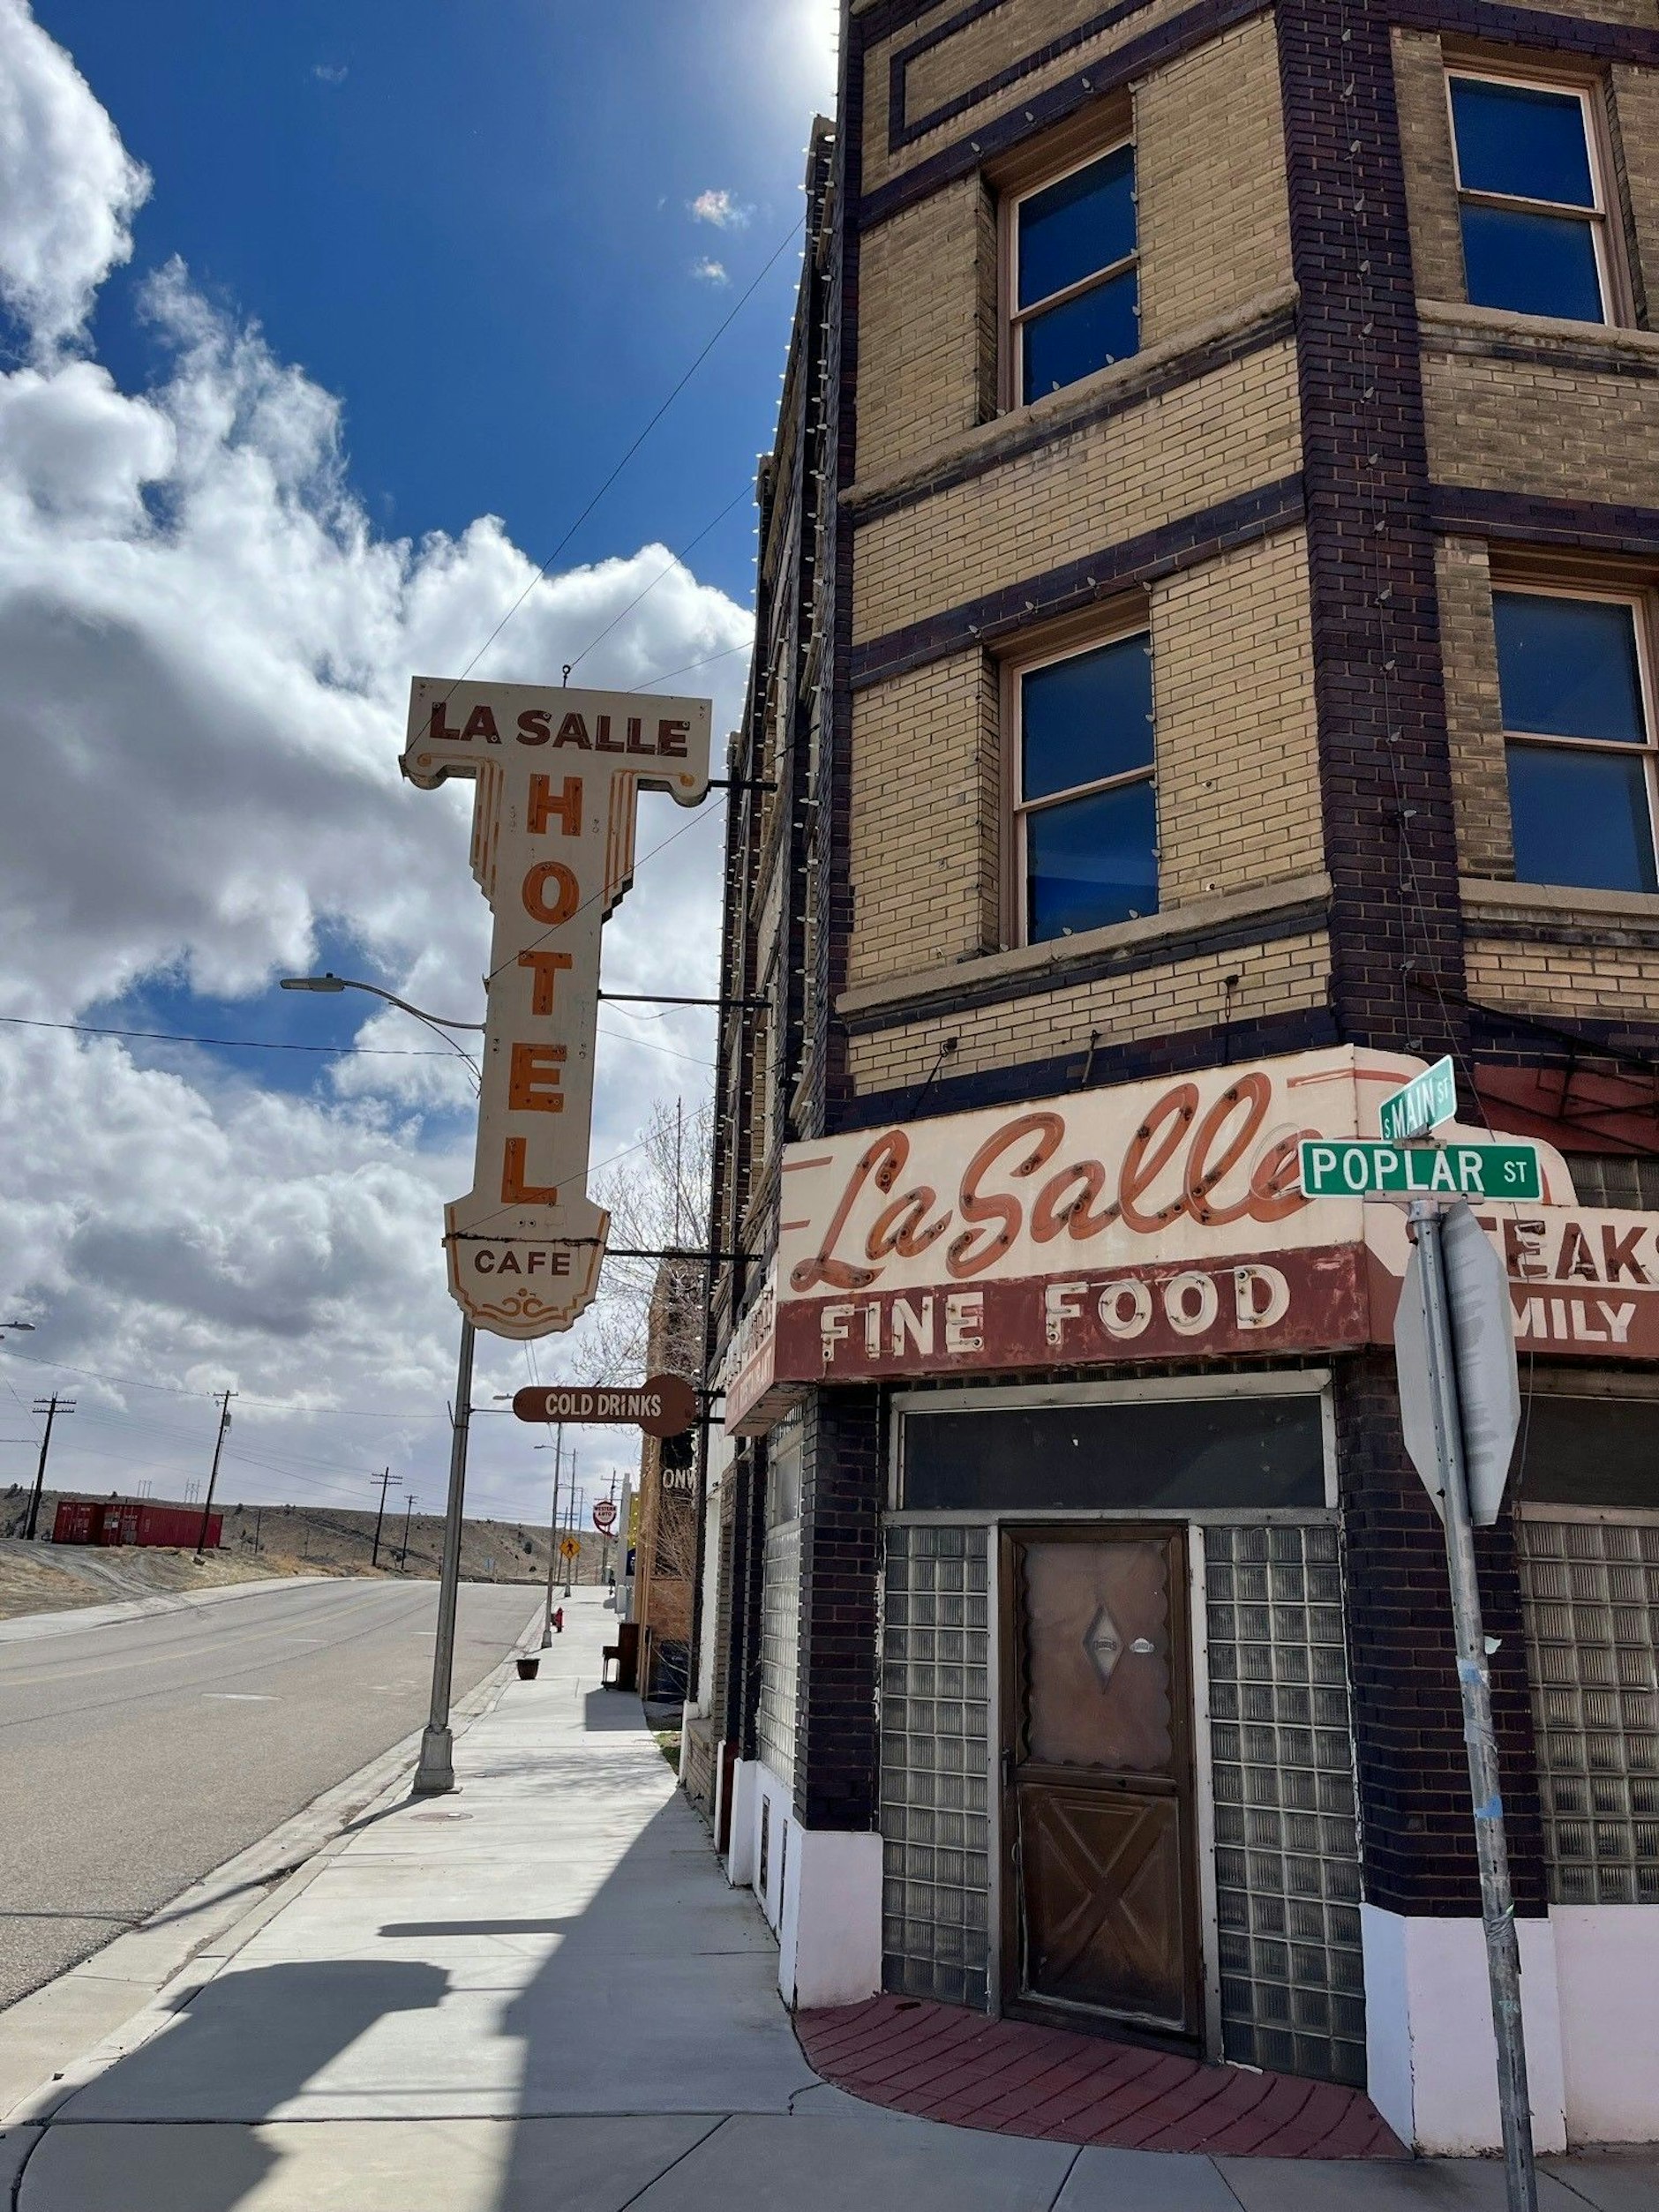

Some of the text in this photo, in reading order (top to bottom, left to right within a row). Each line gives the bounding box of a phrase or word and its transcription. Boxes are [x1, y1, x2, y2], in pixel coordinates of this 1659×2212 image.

[429, 701, 691, 758] LA SALLE
[500, 773, 583, 1205] HOTEL
[1384, 1076, 1449, 1139] S MAIN ST
[1311, 1148, 1528, 1193] POPLAR ST
[473, 1248, 571, 1277] CAFE
[820, 1290, 985, 1362] FINE
[1045, 1263, 1291, 1346] FOOD
[544, 1393, 662, 1417] COLD DRINKS
